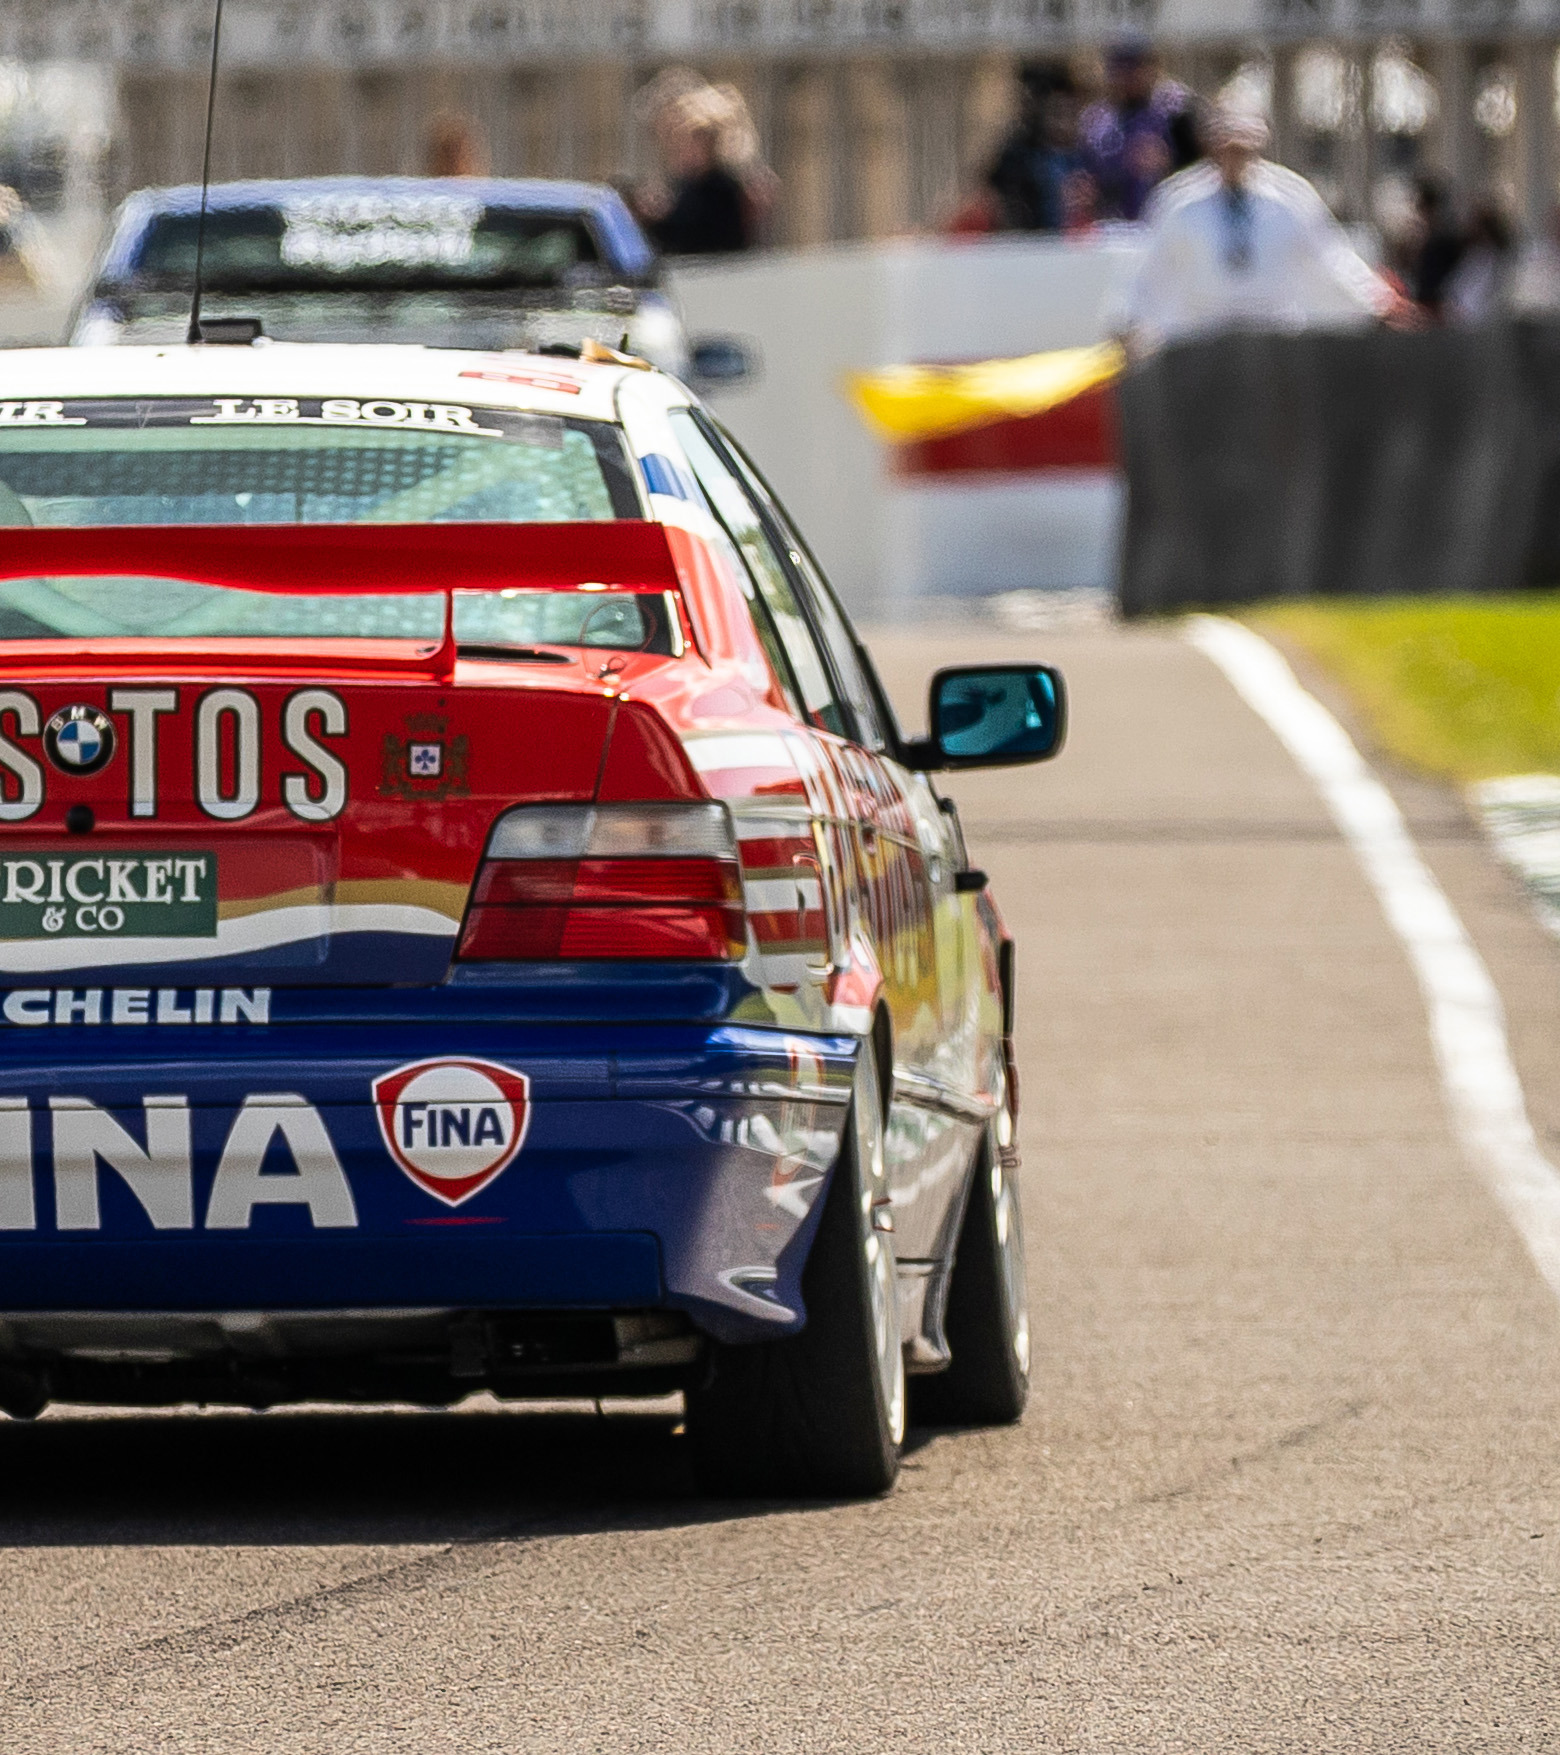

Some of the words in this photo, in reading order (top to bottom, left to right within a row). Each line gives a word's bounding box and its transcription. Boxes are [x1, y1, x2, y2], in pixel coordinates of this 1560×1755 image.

[213, 399, 300, 420] LE
[321, 399, 479, 429] SOIR
[50, 705, 108, 732] BMW
[41, 905, 67, 932] &
[75, 904, 125, 931] CO
[401, 1101, 505, 1149] FINA
